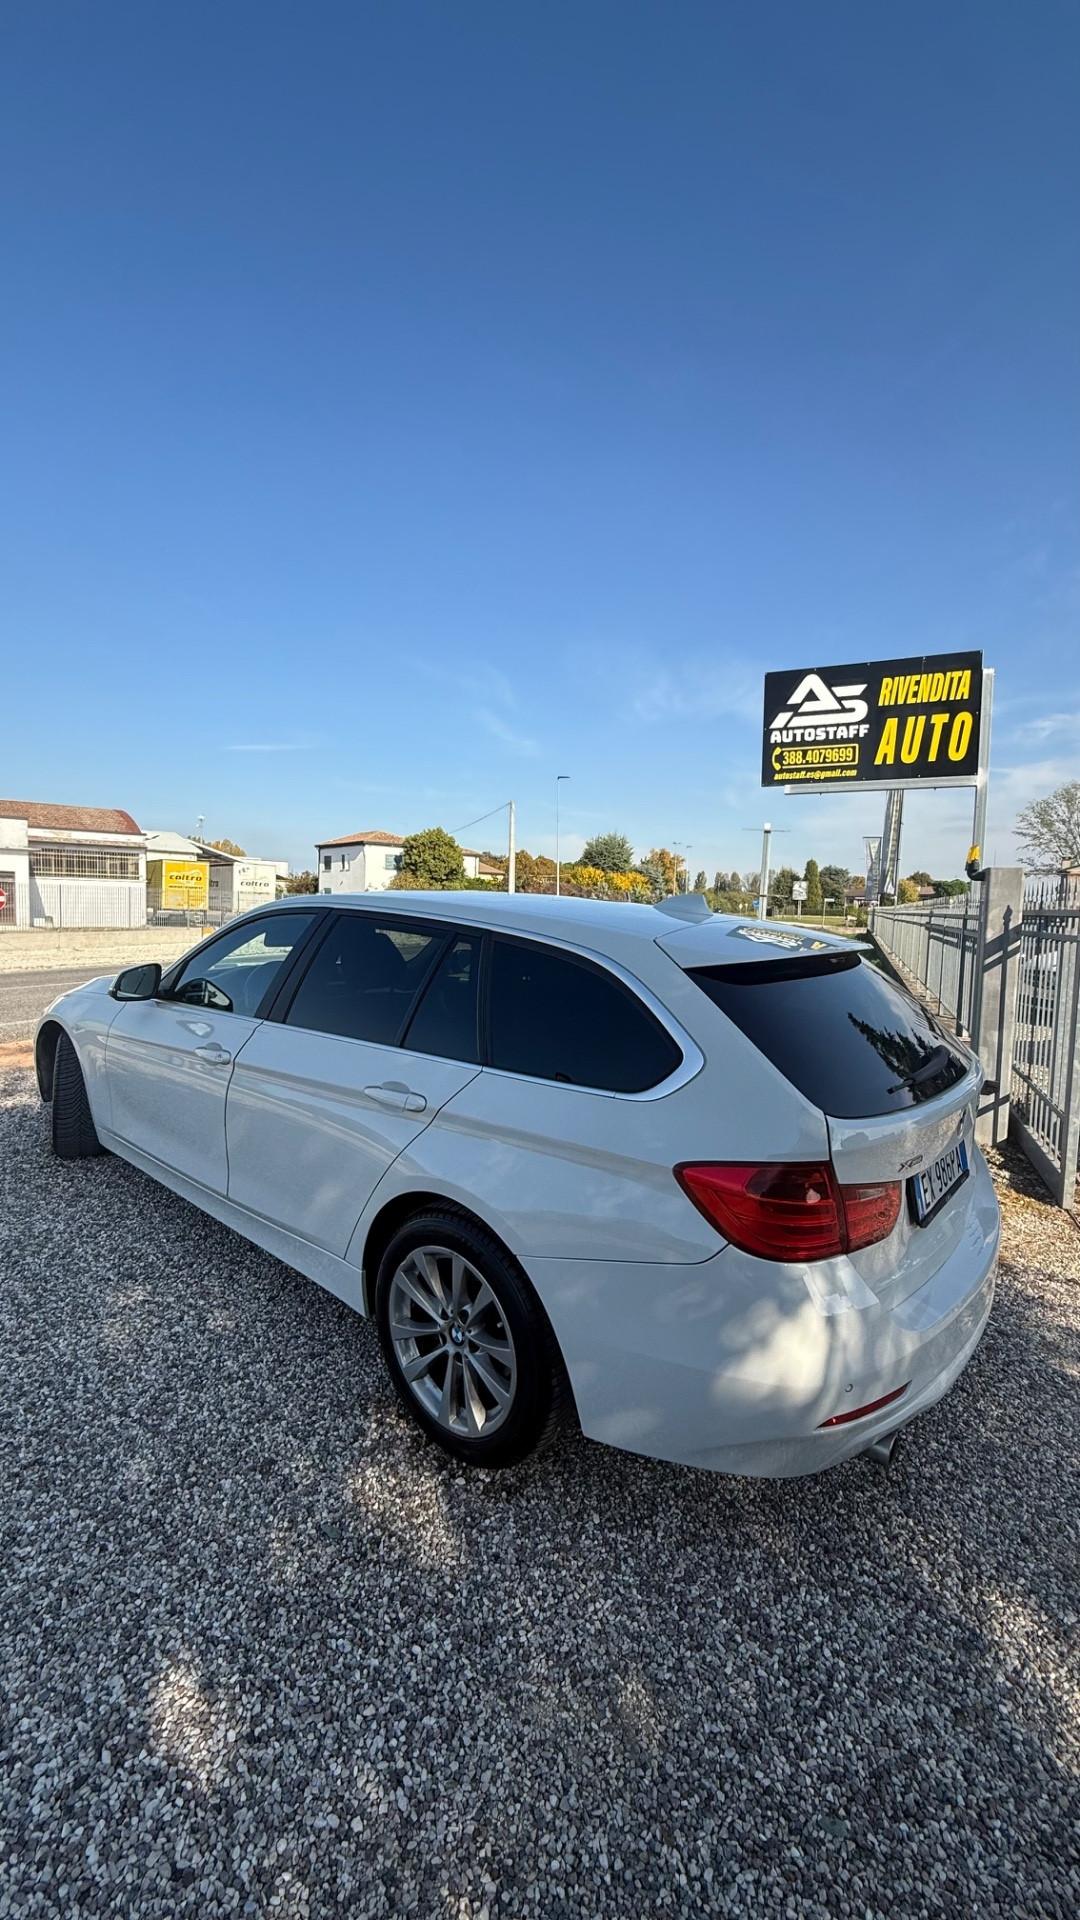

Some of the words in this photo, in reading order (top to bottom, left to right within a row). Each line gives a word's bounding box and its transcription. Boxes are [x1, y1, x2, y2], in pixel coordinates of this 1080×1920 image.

[878, 669, 972, 707] RIVENDITA
[770, 724, 870, 744] AUTOSTAFF
[874, 711, 974, 766] AUTO
[782, 747, 854, 765] 388.4079699
